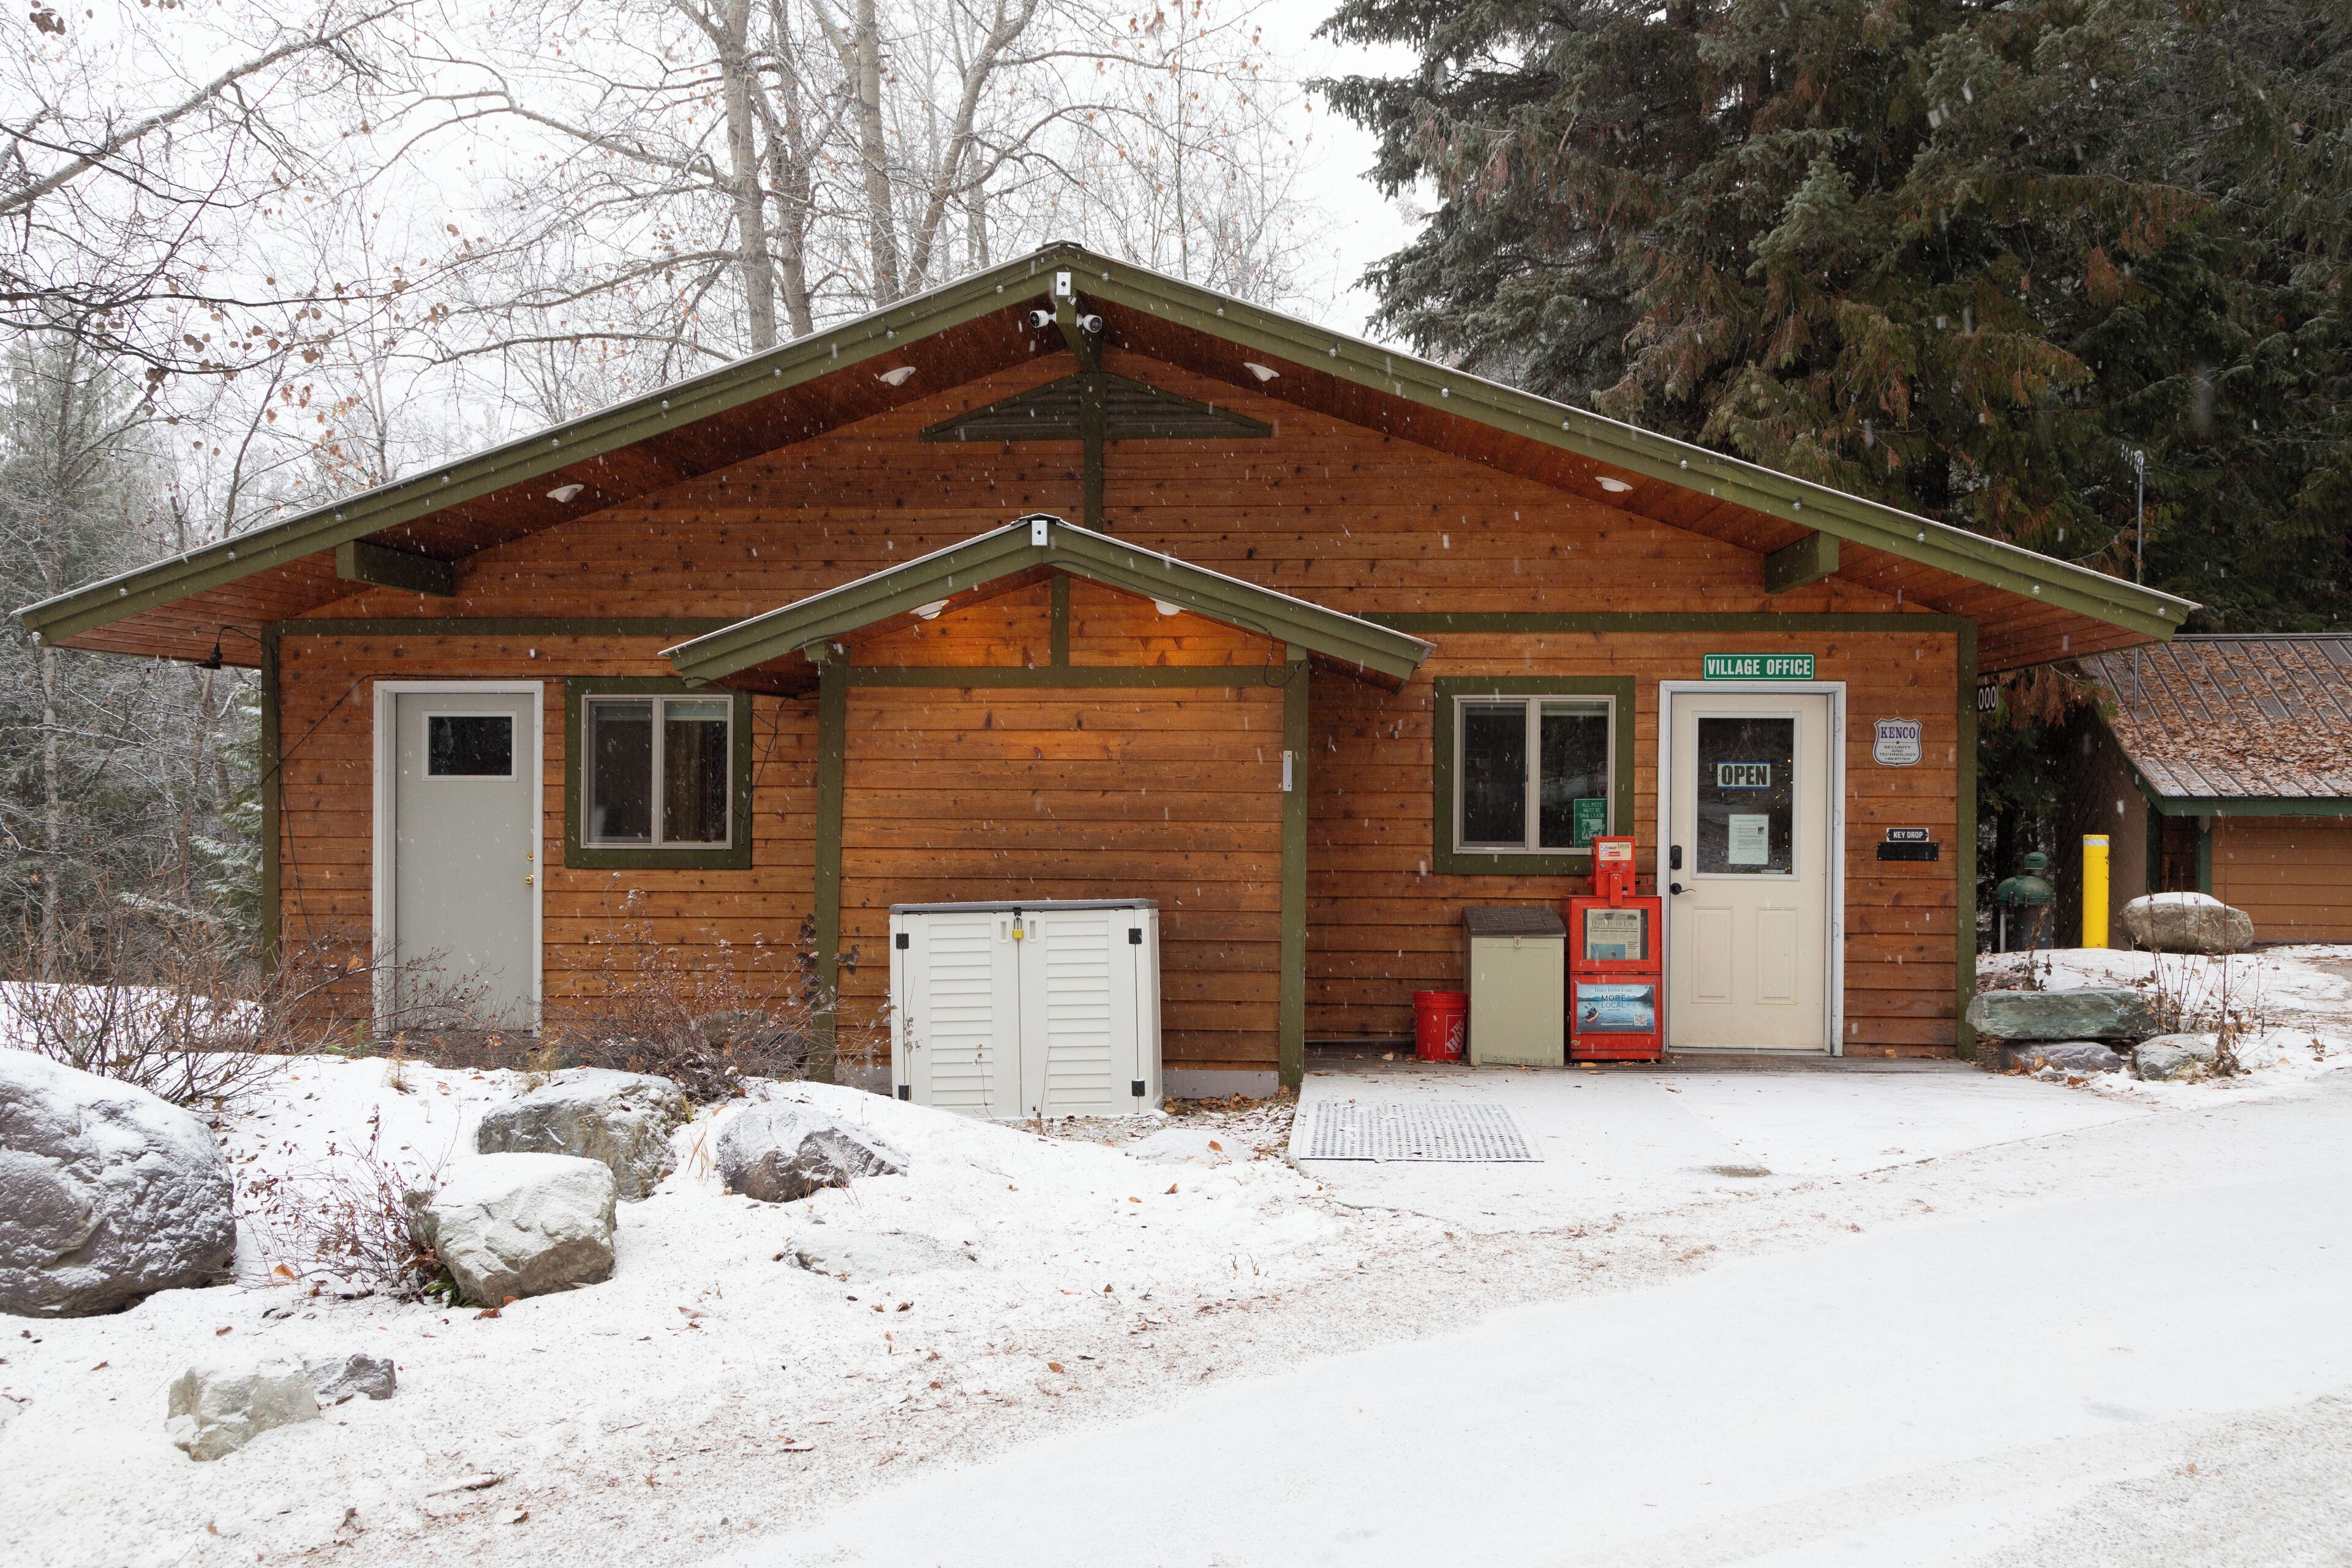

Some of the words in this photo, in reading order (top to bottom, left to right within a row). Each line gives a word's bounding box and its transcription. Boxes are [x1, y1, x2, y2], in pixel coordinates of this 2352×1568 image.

[1708, 659, 1760, 675] VILLAGE
[1766, 659, 1811, 675] OFFICE
[1880, 726, 1916, 739] KENCO
[1721, 764, 1767, 785] OPEN
[1493, 1056, 1544, 1065] DELIVERIES
